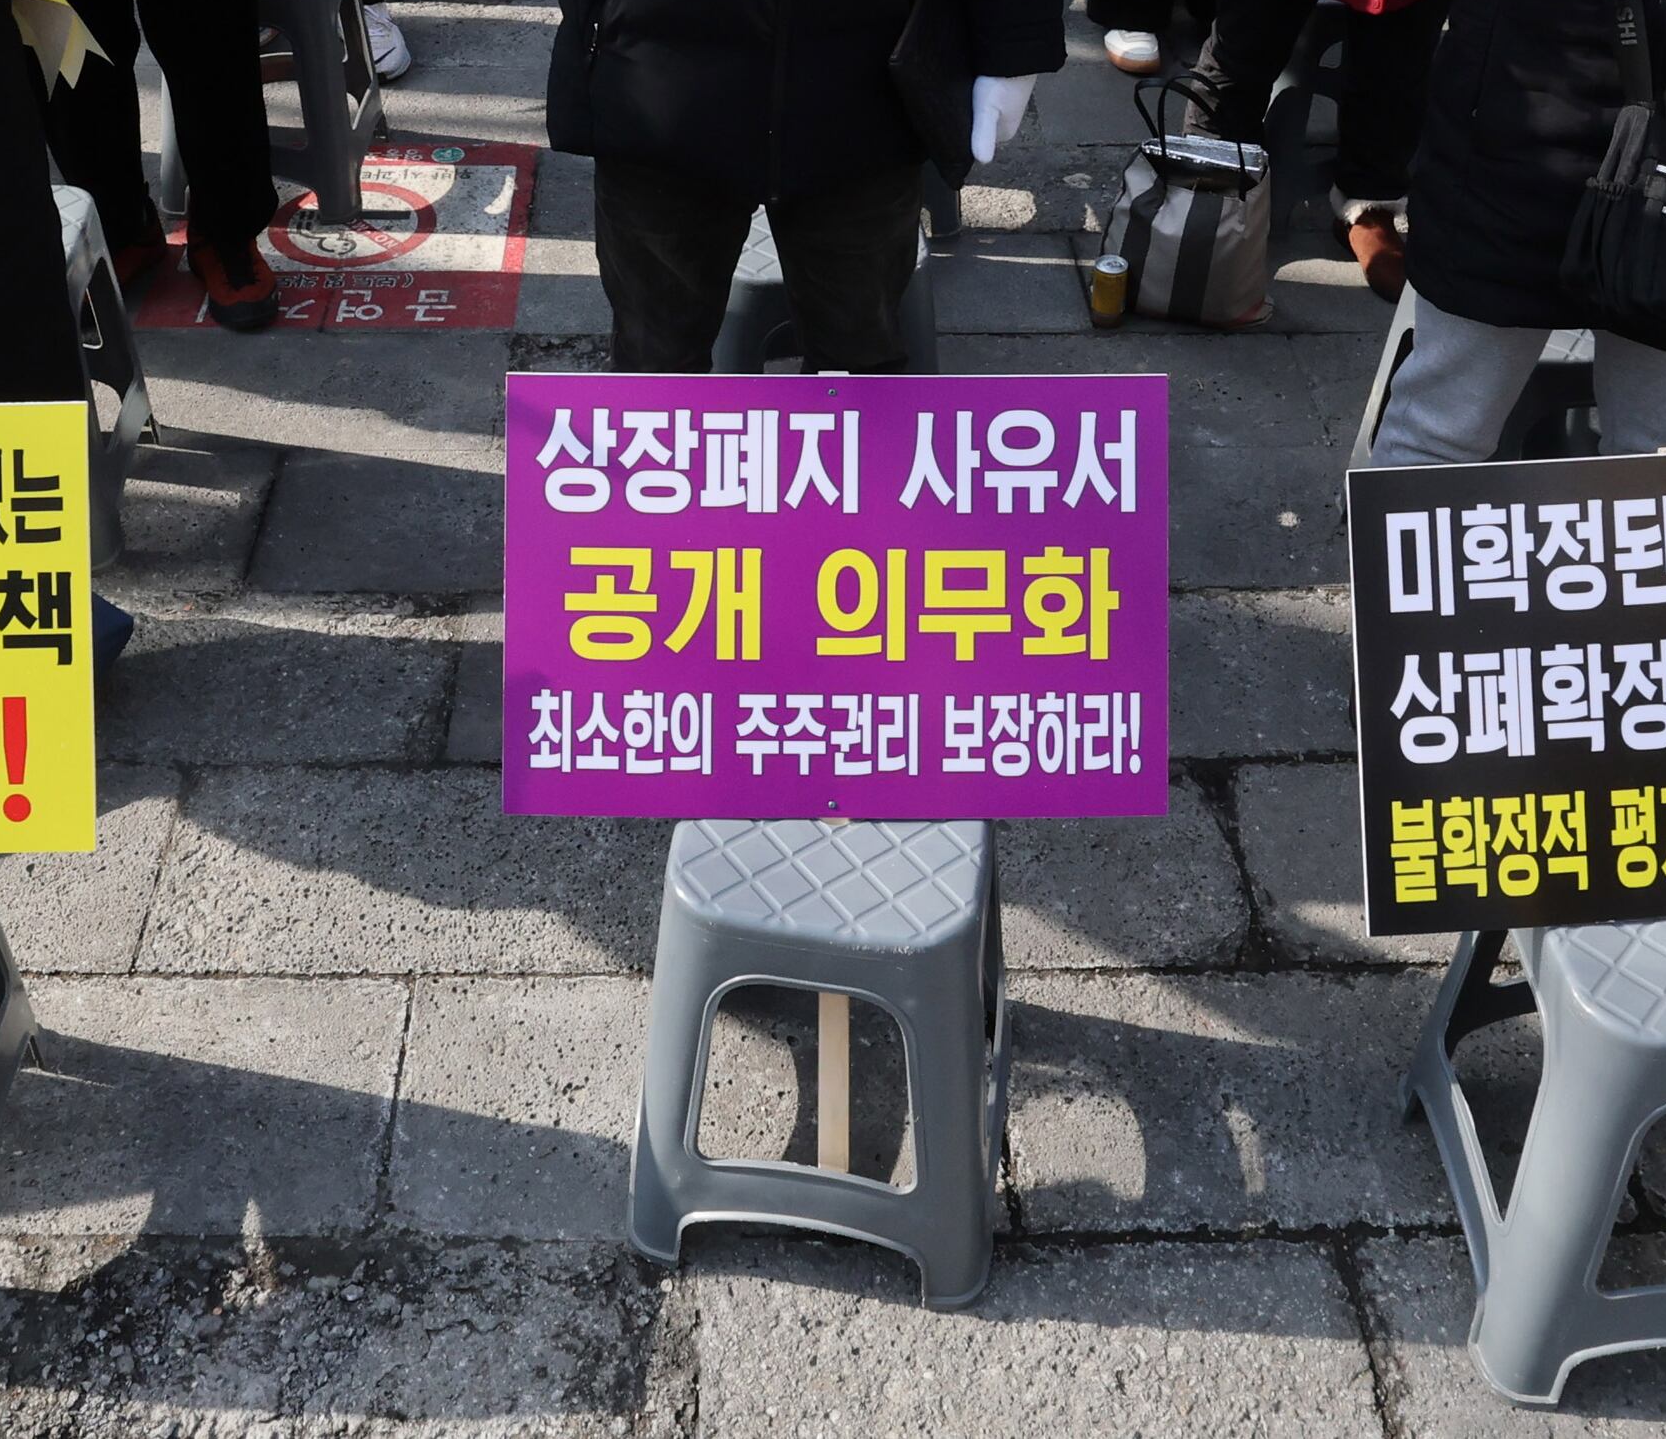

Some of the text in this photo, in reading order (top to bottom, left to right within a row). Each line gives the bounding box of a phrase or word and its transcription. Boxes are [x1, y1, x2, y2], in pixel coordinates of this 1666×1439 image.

[535, 408, 1137, 515] 상장폐지 사유서
[563, 545, 1120, 663] 공개 의무화
[528, 689, 1143, 780] 최소한의 주주권리 보장하라!
[1389, 790, 1590, 904] 불확정적
